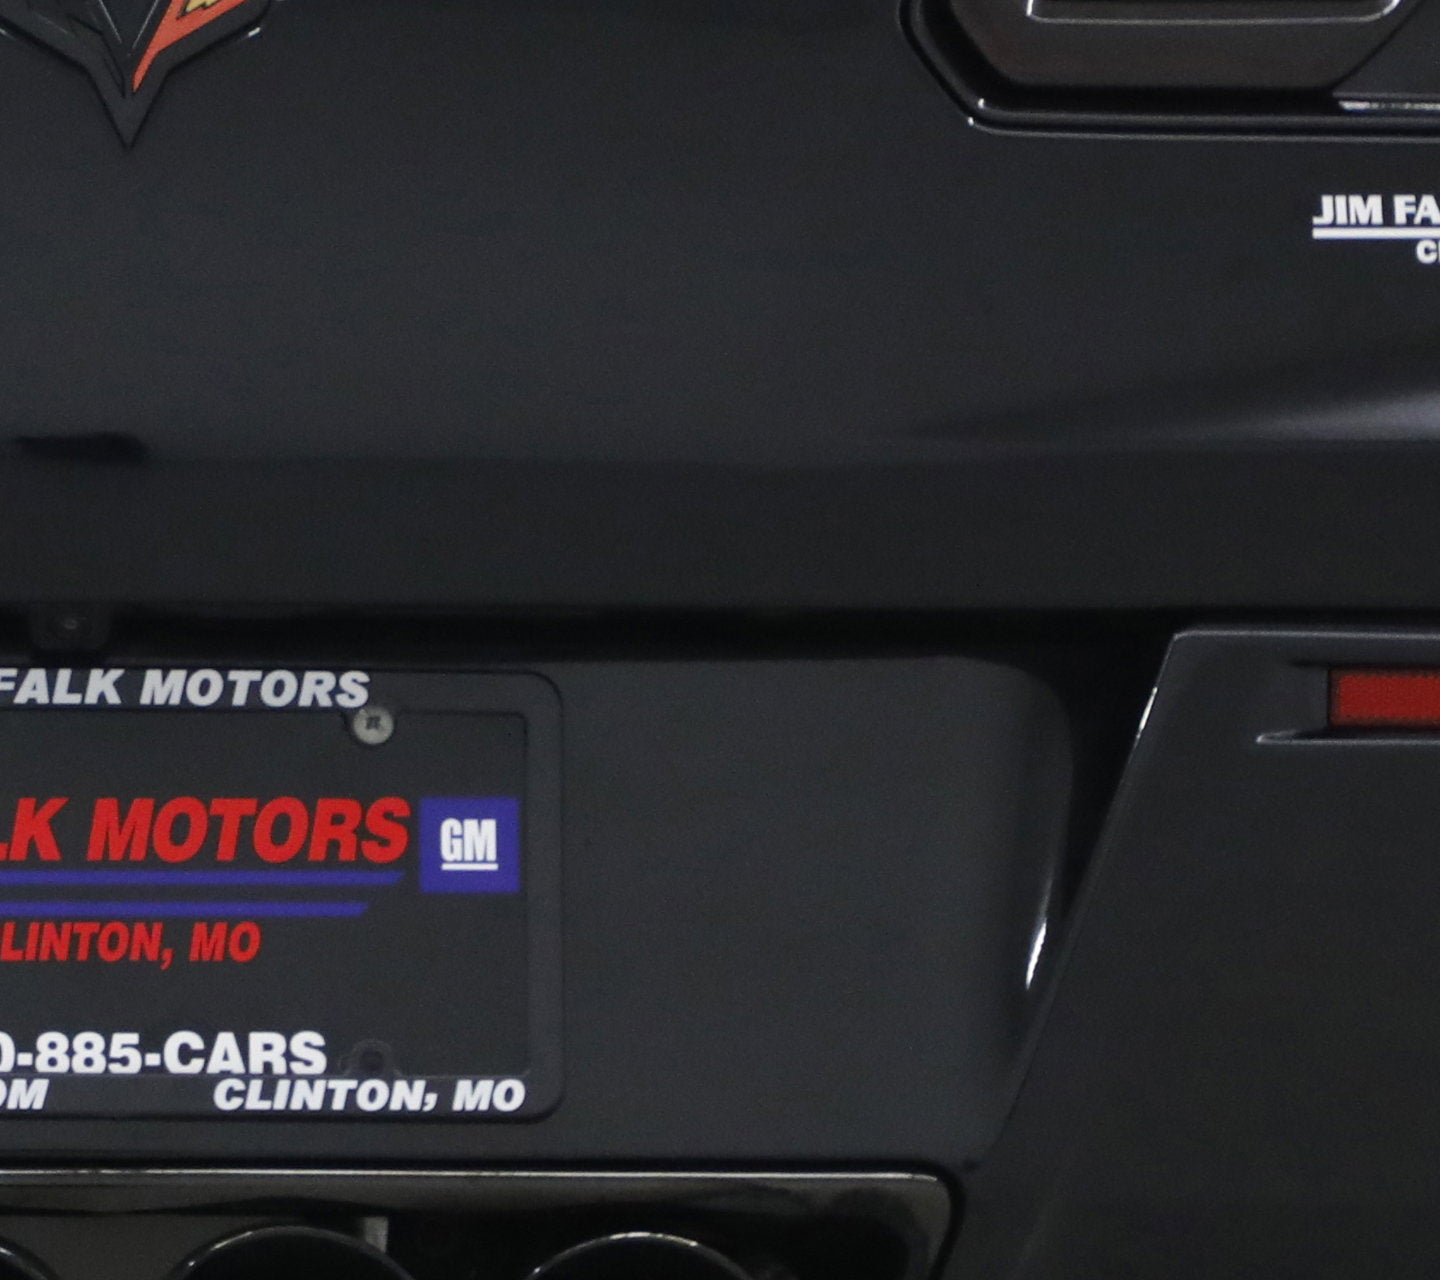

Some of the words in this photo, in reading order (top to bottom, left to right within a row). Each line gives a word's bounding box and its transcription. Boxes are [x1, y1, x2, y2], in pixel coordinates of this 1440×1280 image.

[1312, 194, 1384, 226] JIM
[139, 669, 370, 708] MOTORS
[86, 796, 412, 864] MOTORS
[439, 817, 498, 864] GM
[188, 921, 262, 963] MO
[213, 1077, 438, 1112] CLINTON,
[451, 1078, 526, 1112] MO
